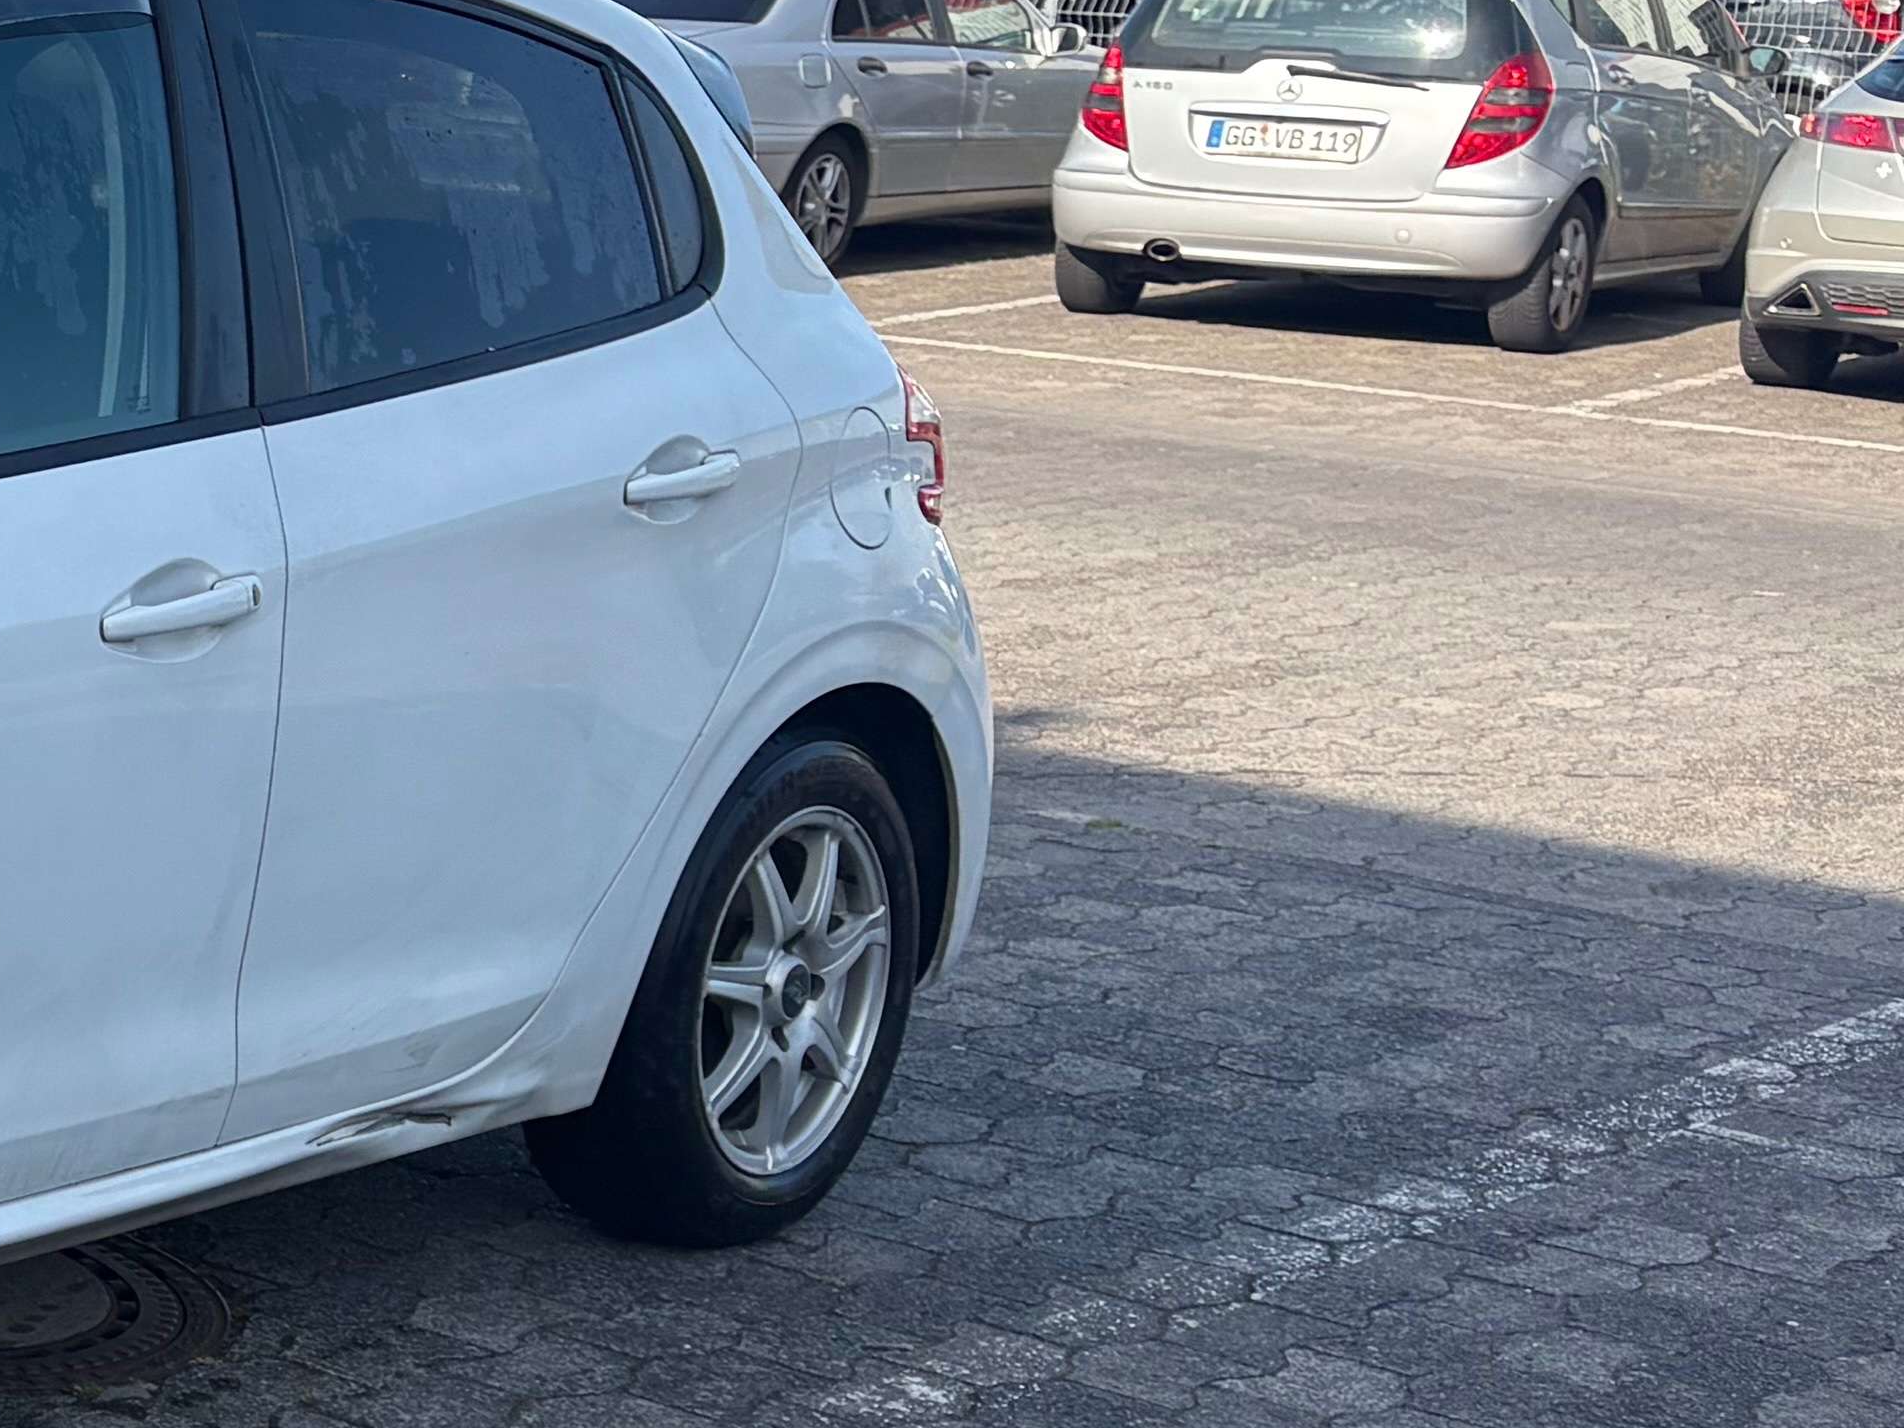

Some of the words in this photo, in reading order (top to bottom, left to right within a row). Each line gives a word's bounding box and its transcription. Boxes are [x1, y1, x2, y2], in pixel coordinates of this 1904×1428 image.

[1224, 125, 1257, 147] GG
[1275, 128, 1305, 150] VB
[1309, 131, 1357, 153] 119
